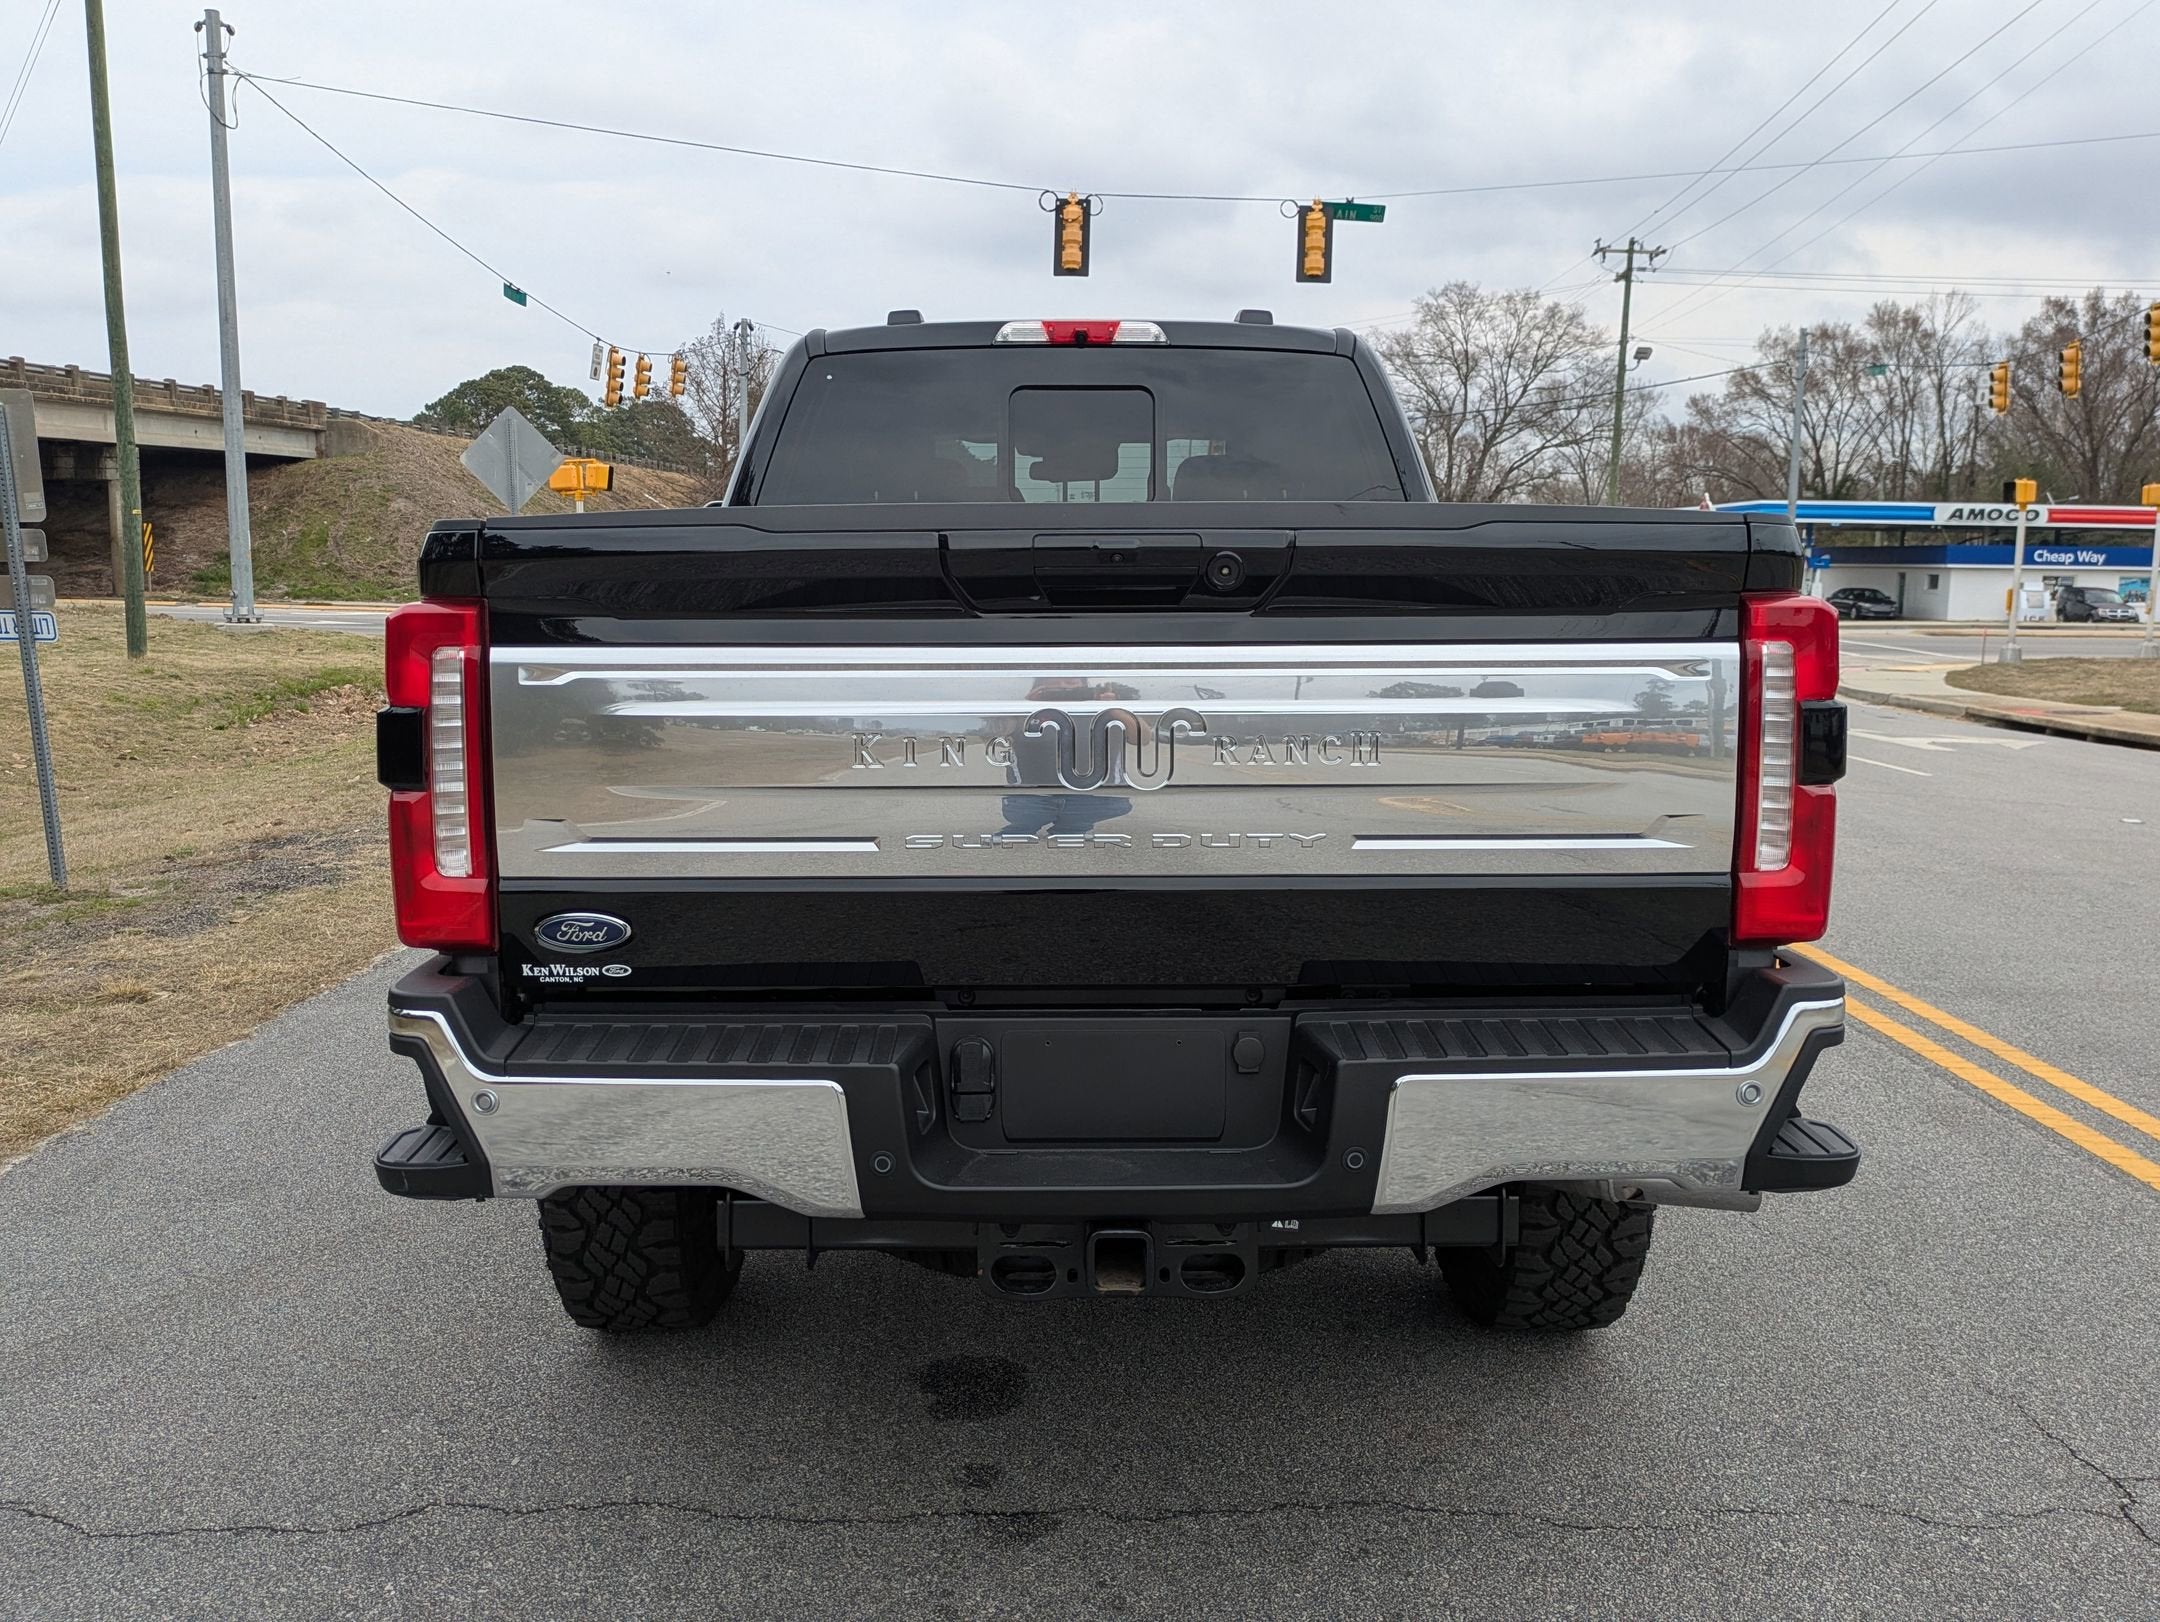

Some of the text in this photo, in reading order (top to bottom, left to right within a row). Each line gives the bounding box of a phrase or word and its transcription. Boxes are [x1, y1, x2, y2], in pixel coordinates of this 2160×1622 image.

[1948, 508, 2040, 522] AMOCO
[2033, 549, 2107, 566] Cheap Way
[850, 729, 1383, 769] KING RANCH
[904, 833, 1327, 849] SUPER DUTY
[556, 920, 607, 942] Ford
[521, 964, 549, 976] KEN
[549, 964, 600, 977] WILSON
